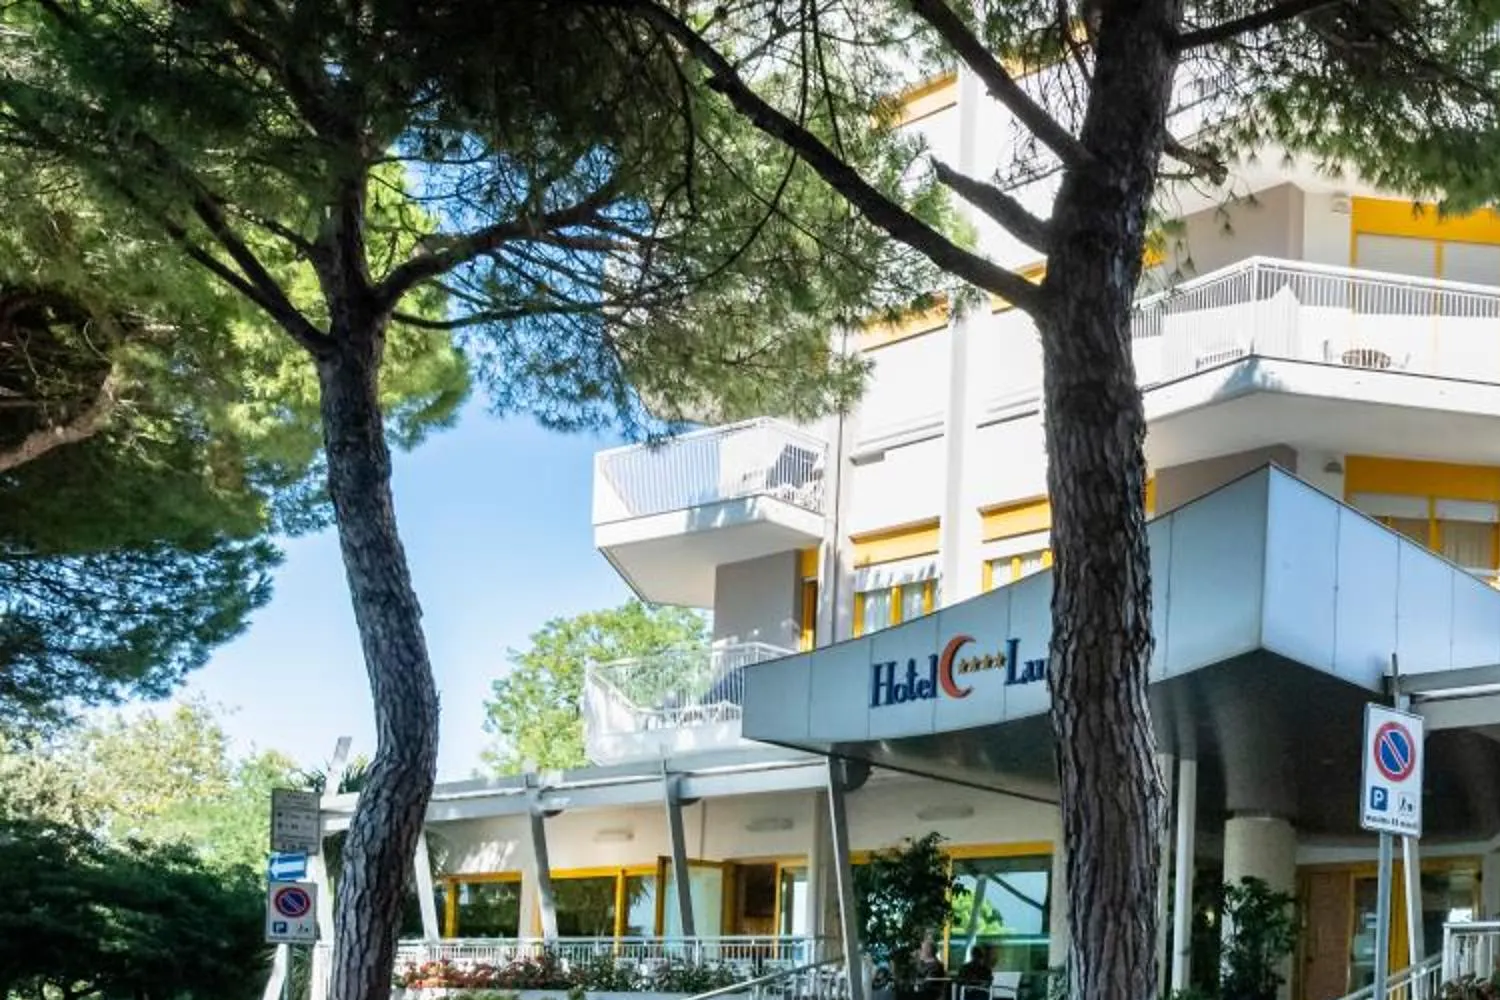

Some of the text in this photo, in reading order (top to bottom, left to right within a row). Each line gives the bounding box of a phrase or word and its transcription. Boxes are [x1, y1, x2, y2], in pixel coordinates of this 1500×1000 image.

[869, 637, 1047, 709] Hotel Lu
[1373, 788, 1385, 807] P
